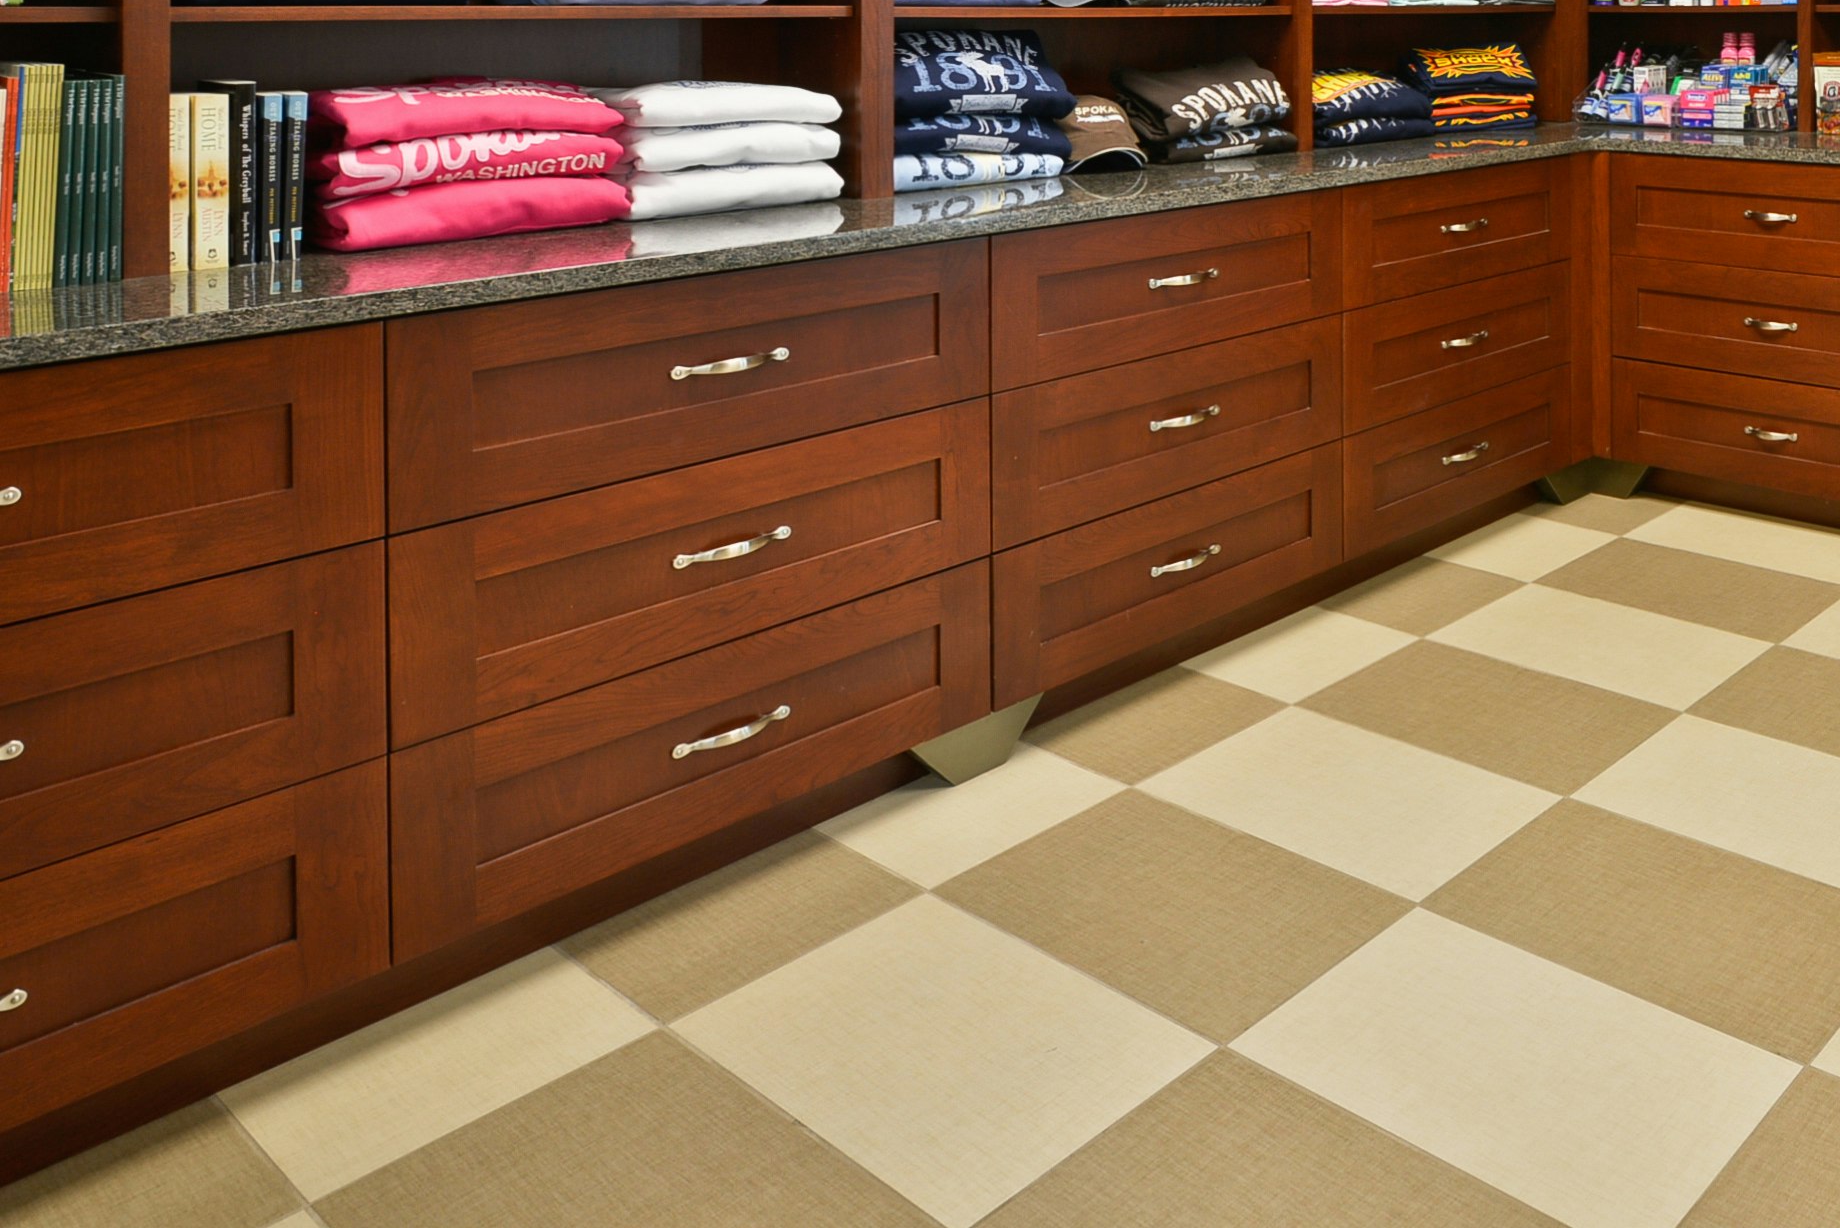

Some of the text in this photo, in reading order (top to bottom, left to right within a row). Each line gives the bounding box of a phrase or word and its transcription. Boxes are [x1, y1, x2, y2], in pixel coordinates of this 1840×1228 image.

[894, 30, 1038, 70] SPOKANE
[914, 52, 1058, 93] 1891
[1074, 105, 1119, 116] SPOKA
[1171, 78, 1291, 130] SPOKANE
[201, 107, 216, 152] HOME
[239, 104, 252, 204] Whispers of The Greybull
[268, 154, 276, 182] HORSES
[291, 153, 300, 181] HORSES
[436, 152, 606, 184] WASHINGTON
[173, 212, 184, 239] LYNN
[201, 207, 213, 242] AUSTIN
[213, 209, 225, 237] LYNN
